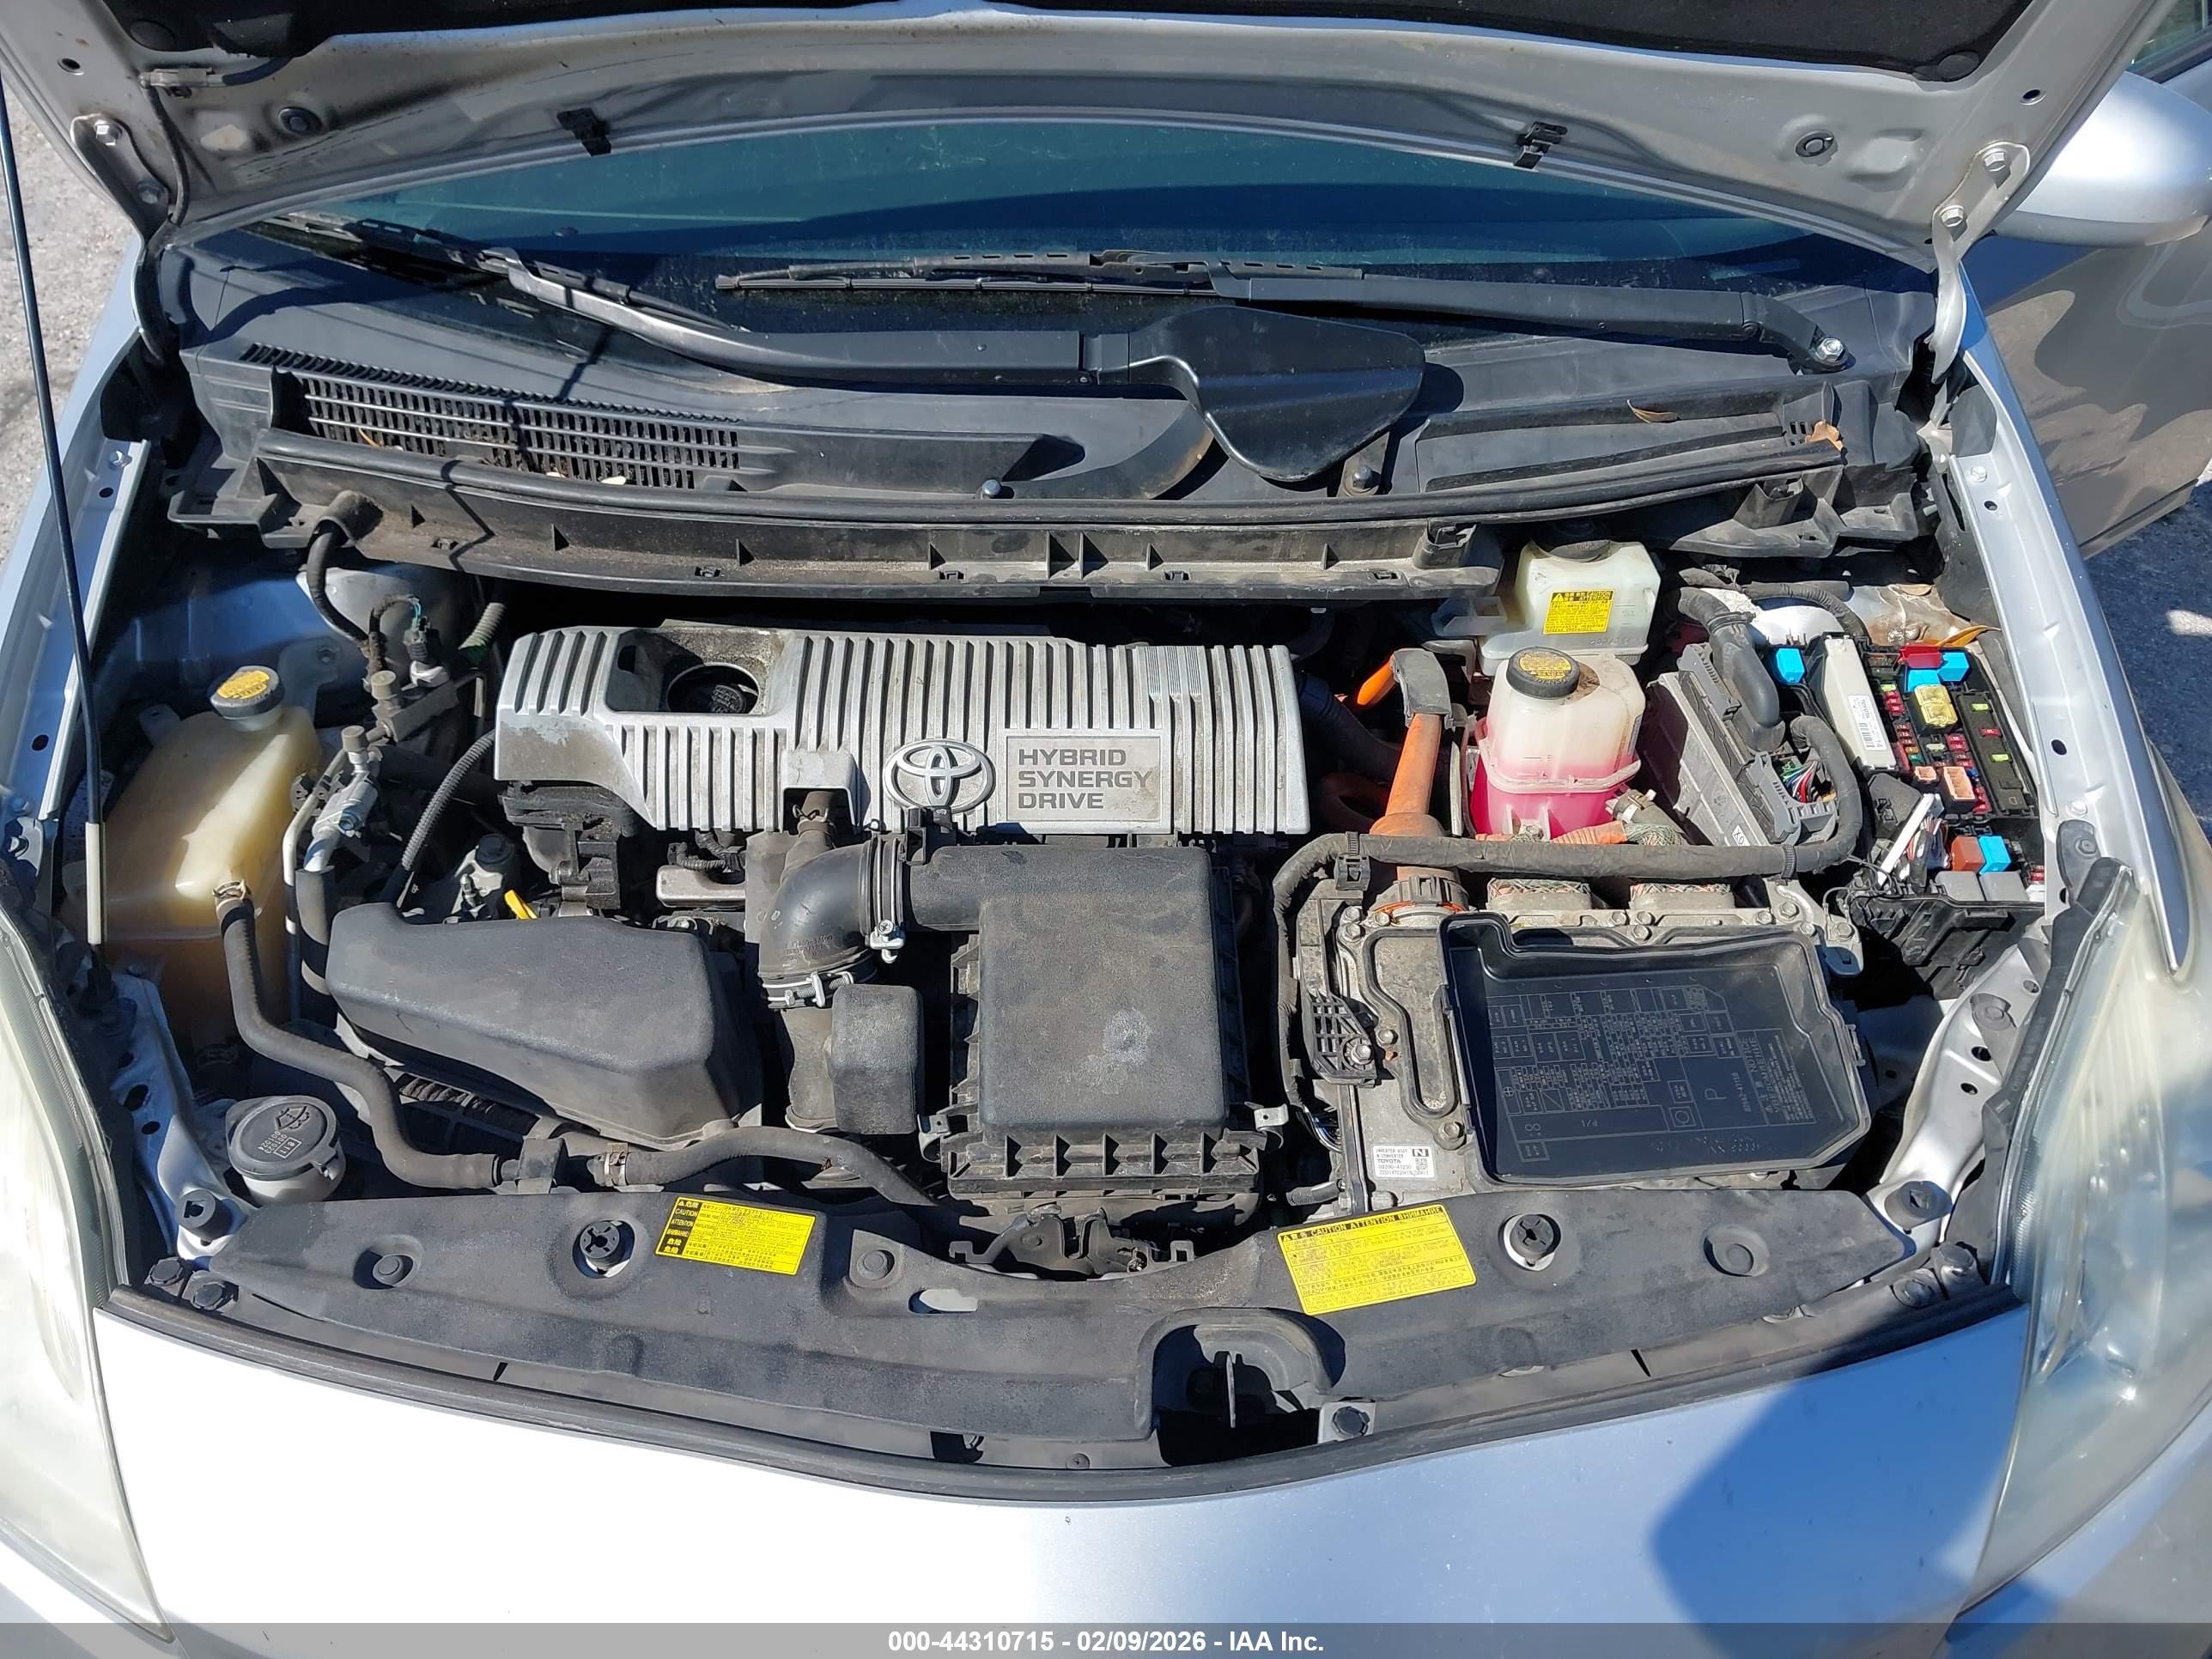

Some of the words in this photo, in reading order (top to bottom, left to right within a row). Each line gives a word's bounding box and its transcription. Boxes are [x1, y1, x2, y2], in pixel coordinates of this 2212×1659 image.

[1018, 749, 1127, 766] HYBRID
[1018, 771, 1152, 787] SYNERGY
[1018, 793, 1104, 809] DRIVE
[1739, 1037, 1758, 1072] NOTICE
[1705, 1087, 1729, 1101] P
[675, 1208, 698, 1217] CAUTION
[1310, 1222, 1347, 1237] CAUTION
[1350, 1215, 1396, 1229] ATTENTION
